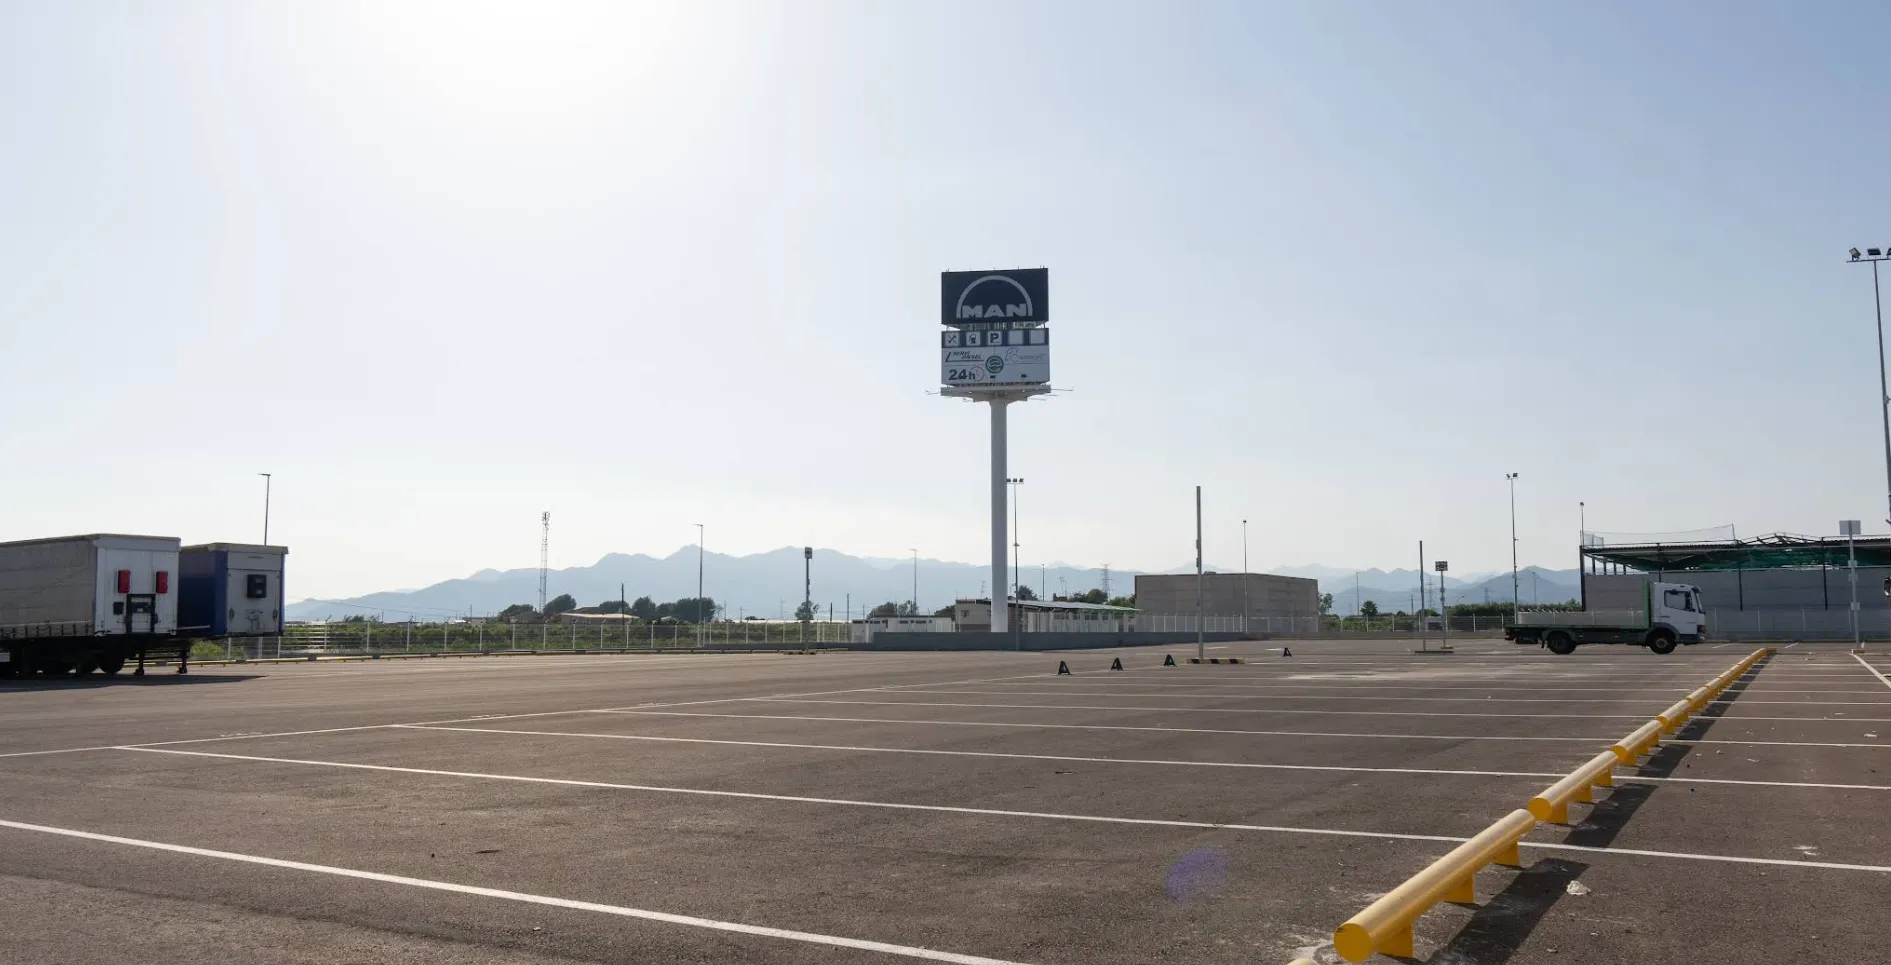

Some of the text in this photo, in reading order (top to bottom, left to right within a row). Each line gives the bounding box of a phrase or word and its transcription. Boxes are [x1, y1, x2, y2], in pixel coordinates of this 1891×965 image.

[962, 303, 1027, 318] MAN
[990, 332, 999, 343] P
[948, 369, 976, 380] 24h
